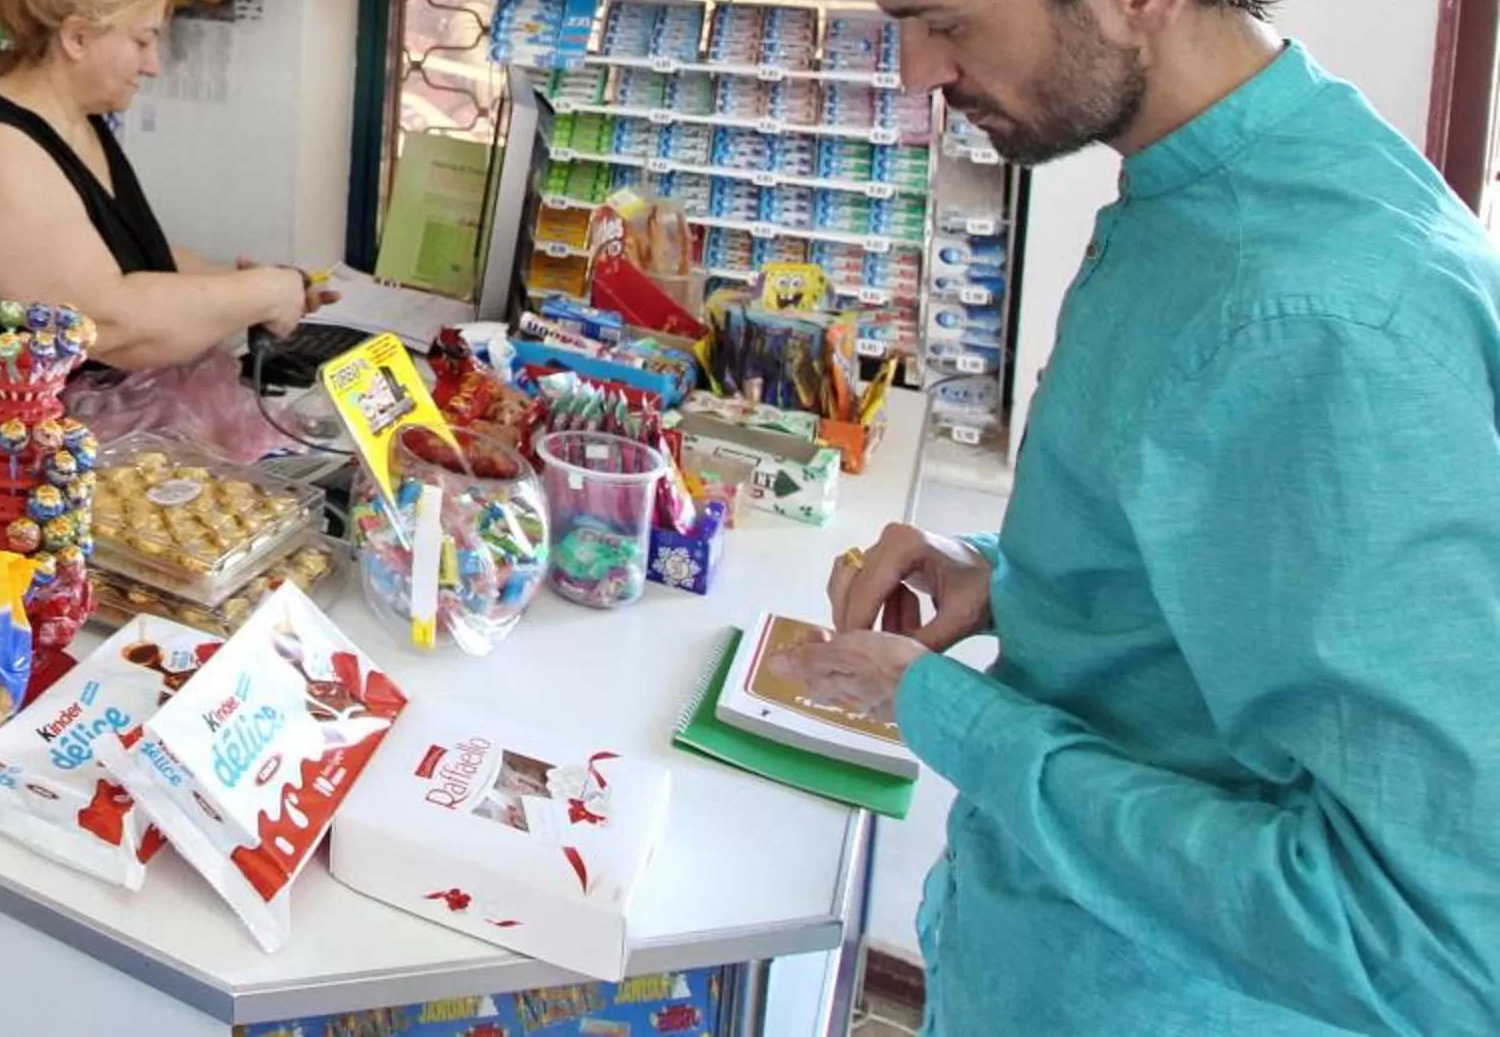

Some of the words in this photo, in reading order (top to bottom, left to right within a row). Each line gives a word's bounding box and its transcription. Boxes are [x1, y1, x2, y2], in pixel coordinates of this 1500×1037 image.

[36, 702, 83, 744] Kinder
[203, 693, 242, 733] Kinder
[425, 736, 492, 811] Raffaello
